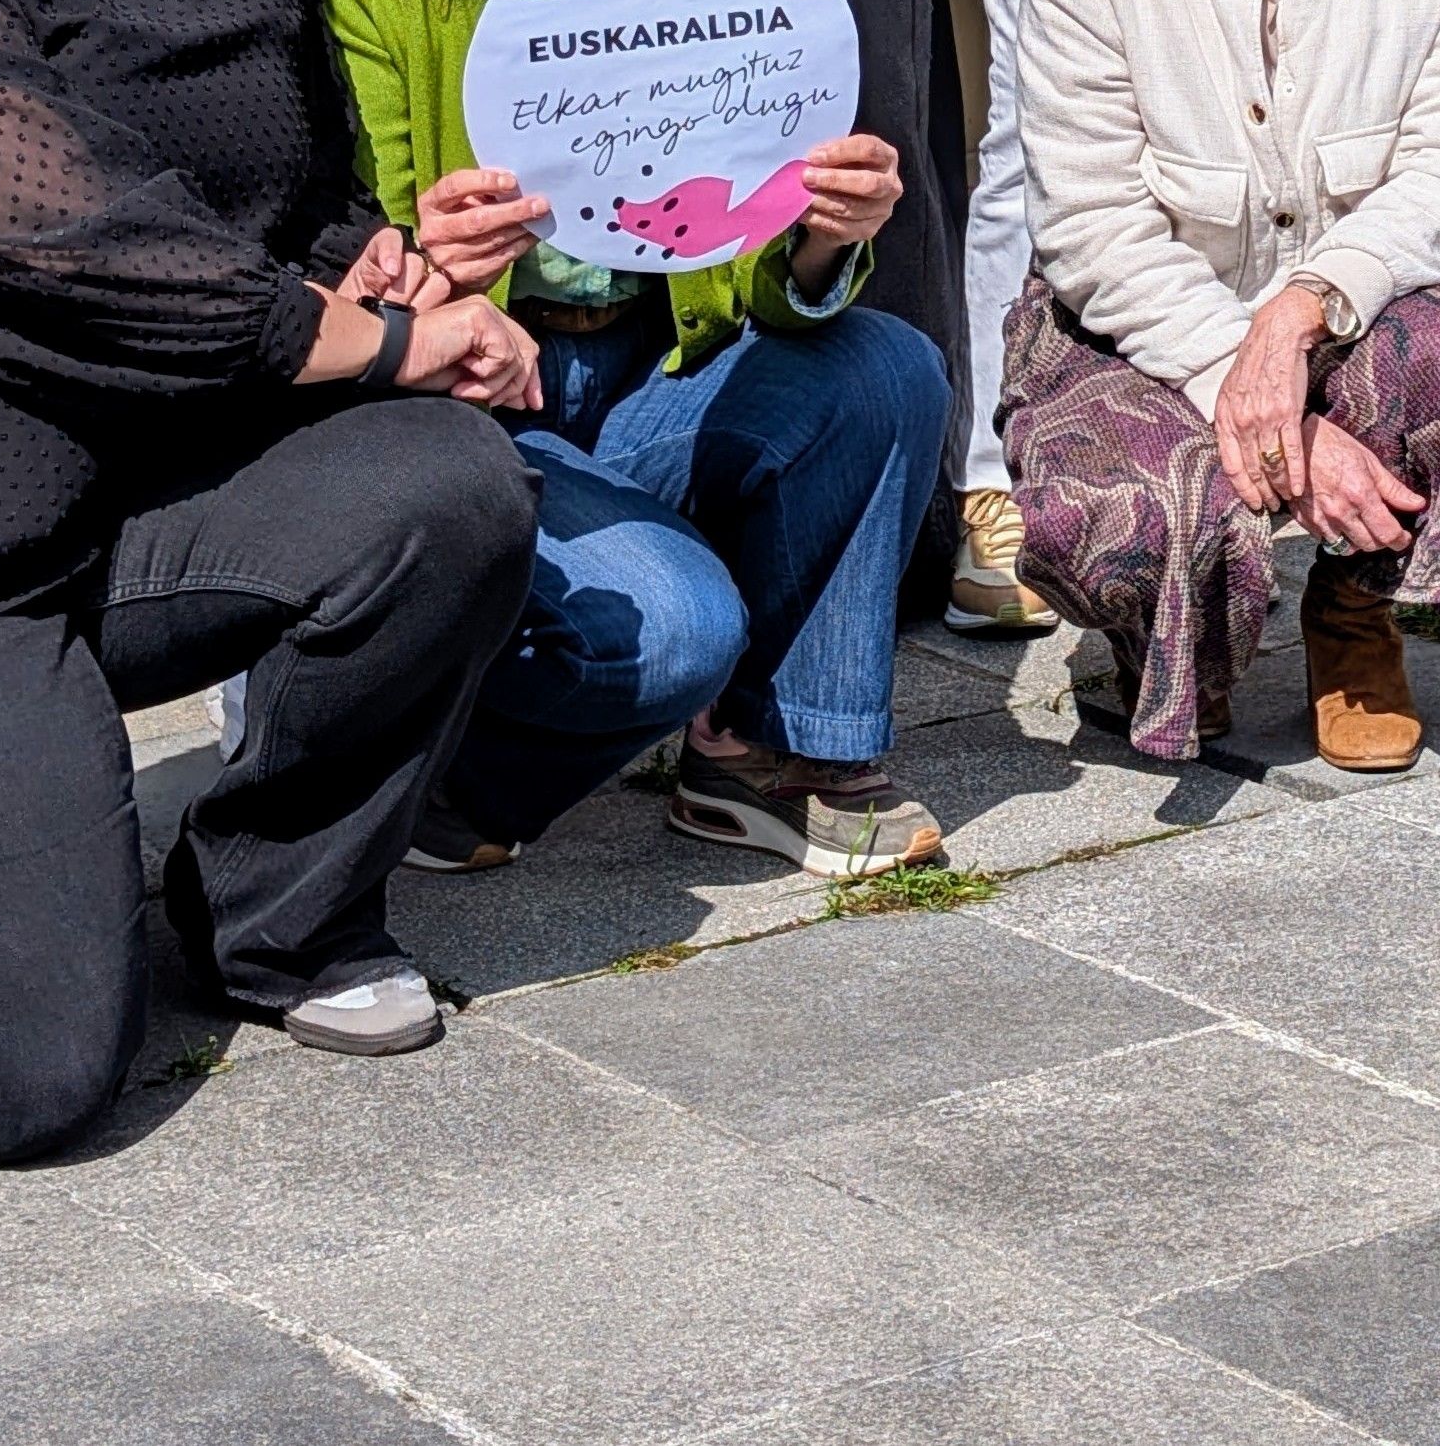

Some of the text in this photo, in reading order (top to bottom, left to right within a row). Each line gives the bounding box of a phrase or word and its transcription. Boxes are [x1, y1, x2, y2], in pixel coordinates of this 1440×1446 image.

[528, 5, 795, 64] EUSKARALDIA
[511, 47, 804, 132] Elkar mugituz
[570, 84, 841, 177] egingo dugu
